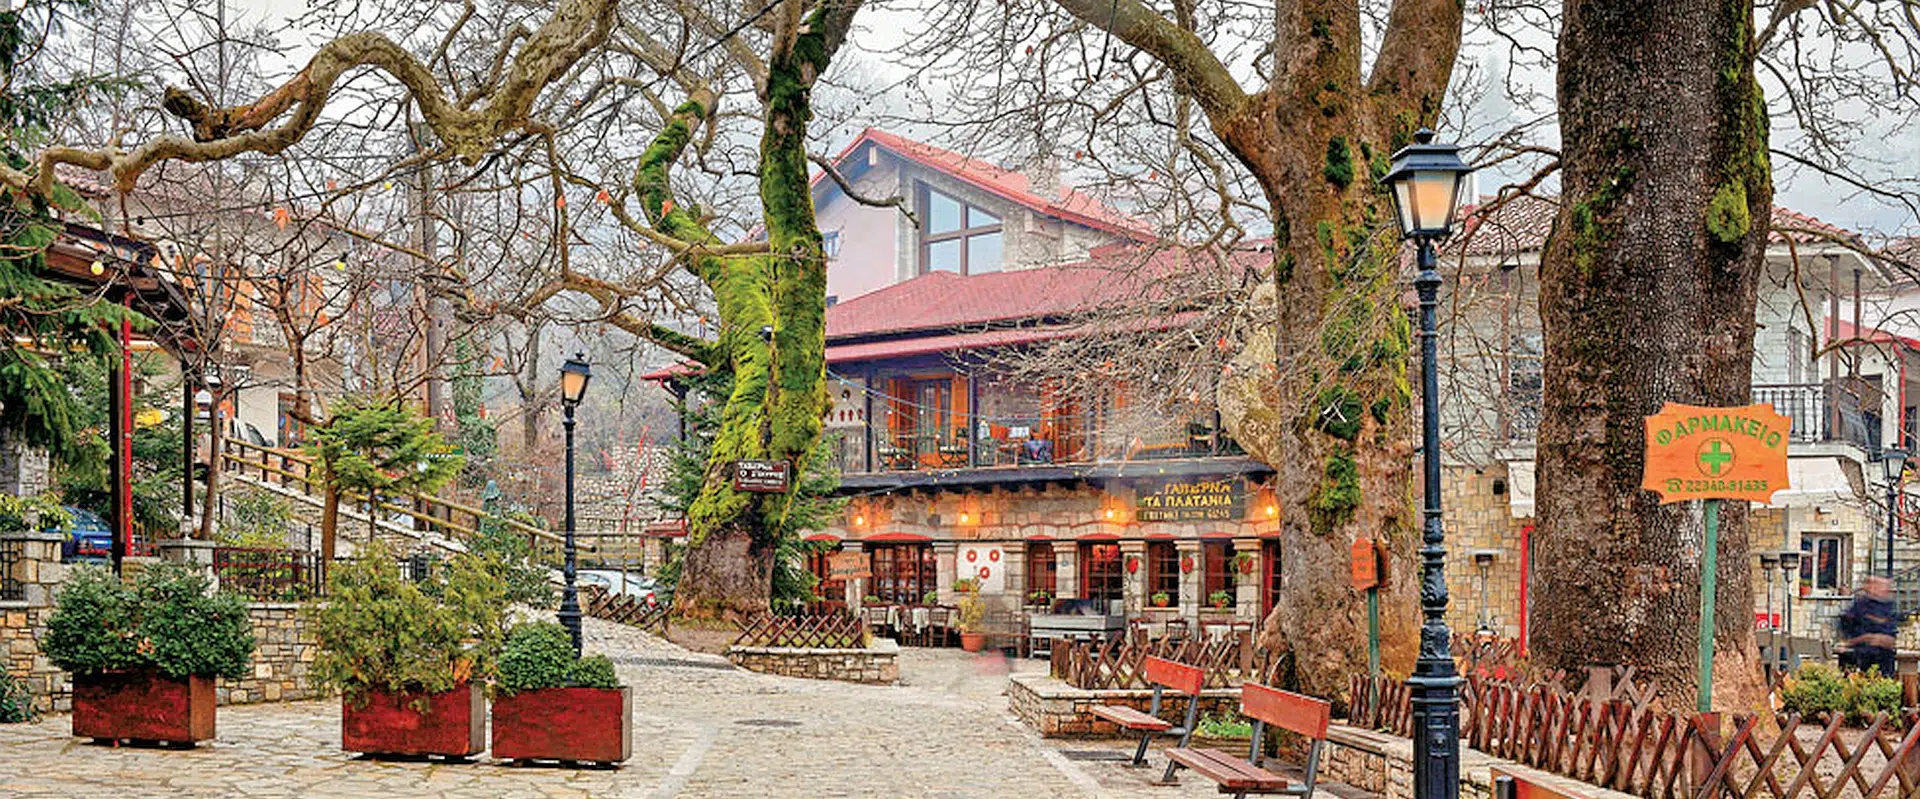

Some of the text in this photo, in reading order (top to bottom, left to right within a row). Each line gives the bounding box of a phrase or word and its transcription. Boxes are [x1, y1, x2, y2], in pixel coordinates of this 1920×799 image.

[1656, 414, 1782, 449] ΦΑΡΜΑΚΕΙΟ
[1143, 494, 1232, 507] ΤΑ ΠΛΑΤΑΝΙΑ
